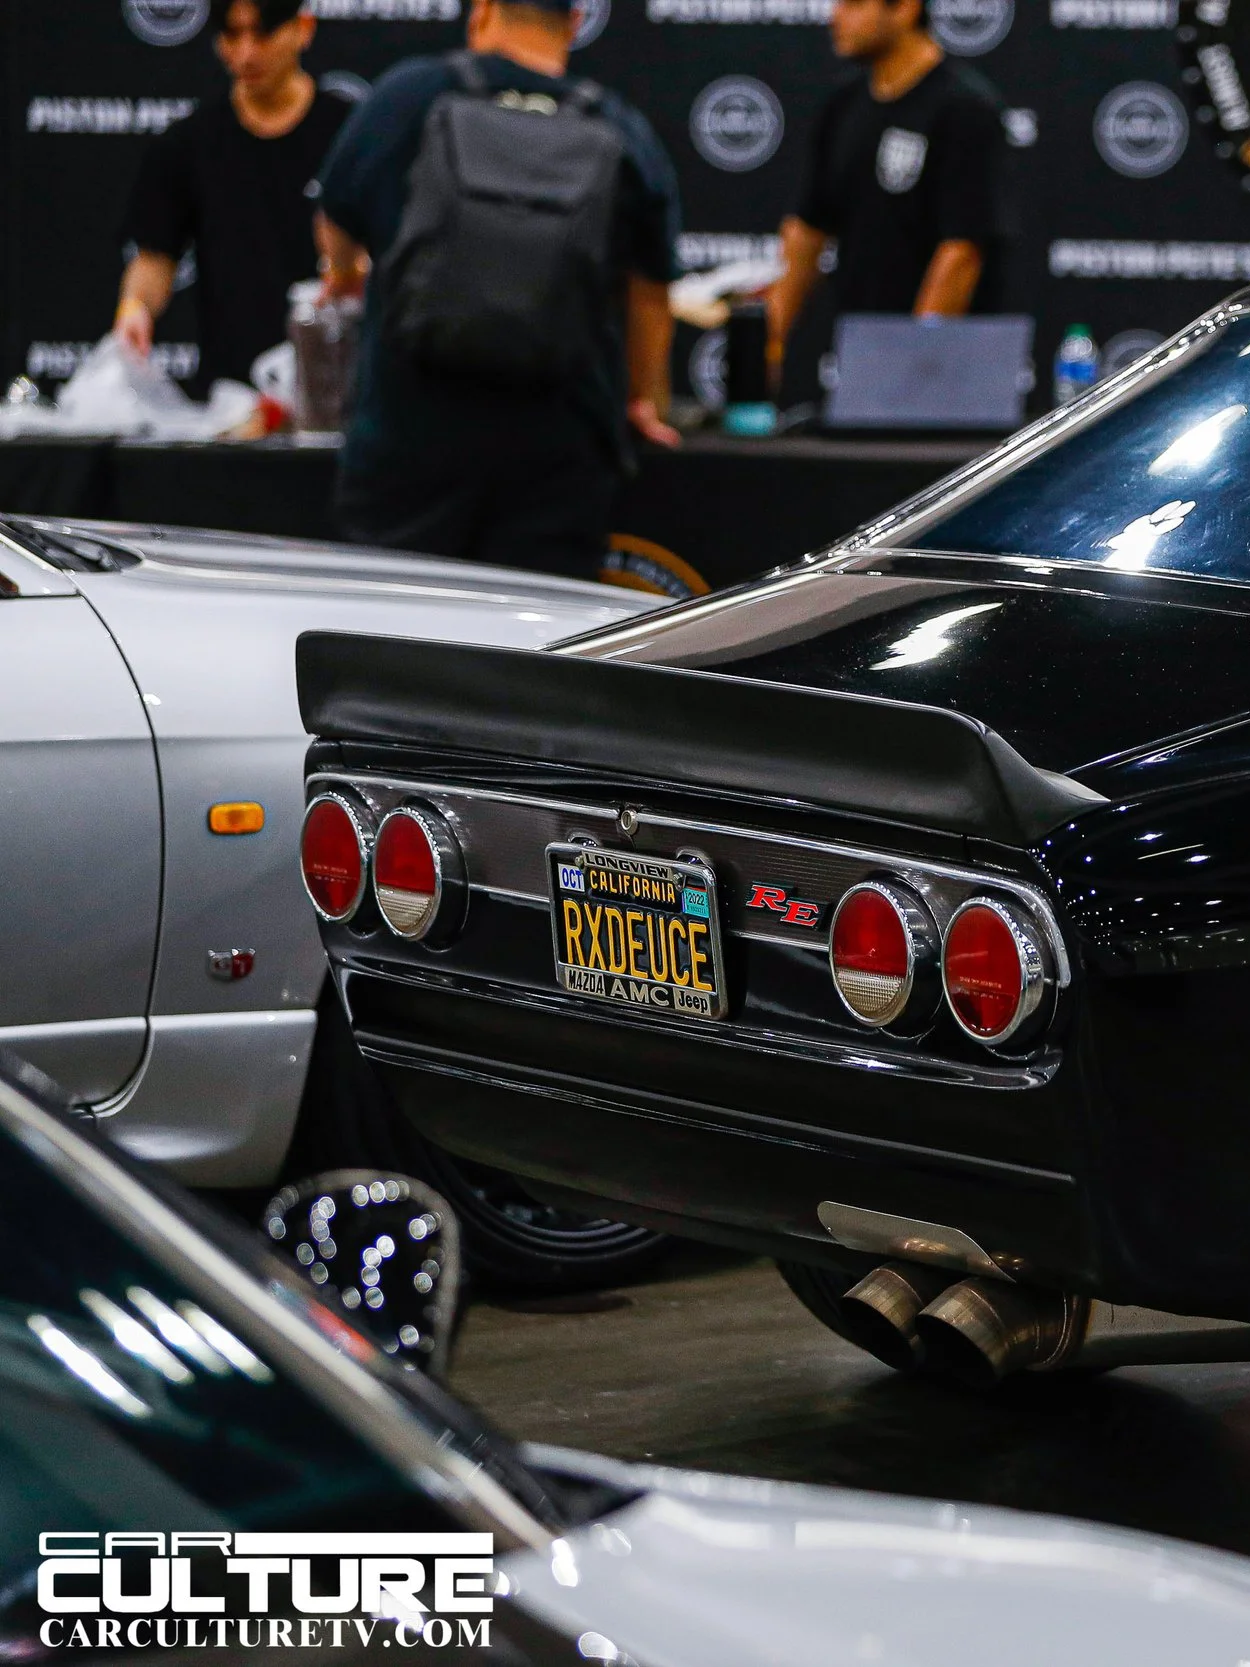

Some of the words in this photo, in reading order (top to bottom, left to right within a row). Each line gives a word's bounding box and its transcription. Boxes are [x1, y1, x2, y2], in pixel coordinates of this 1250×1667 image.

[562, 867, 582, 888] OCT
[584, 853, 669, 878] LONGVIEW
[590, 870, 676, 904] CALIFORNIA
[688, 891, 705, 906] 2022
[747, 884, 820, 927] RE
[563, 900, 713, 991] RXDEUCE
[568, 969, 605, 994] MAZDA
[610, 978, 669, 1006] AMC
[678, 990, 708, 1013] Jeep
